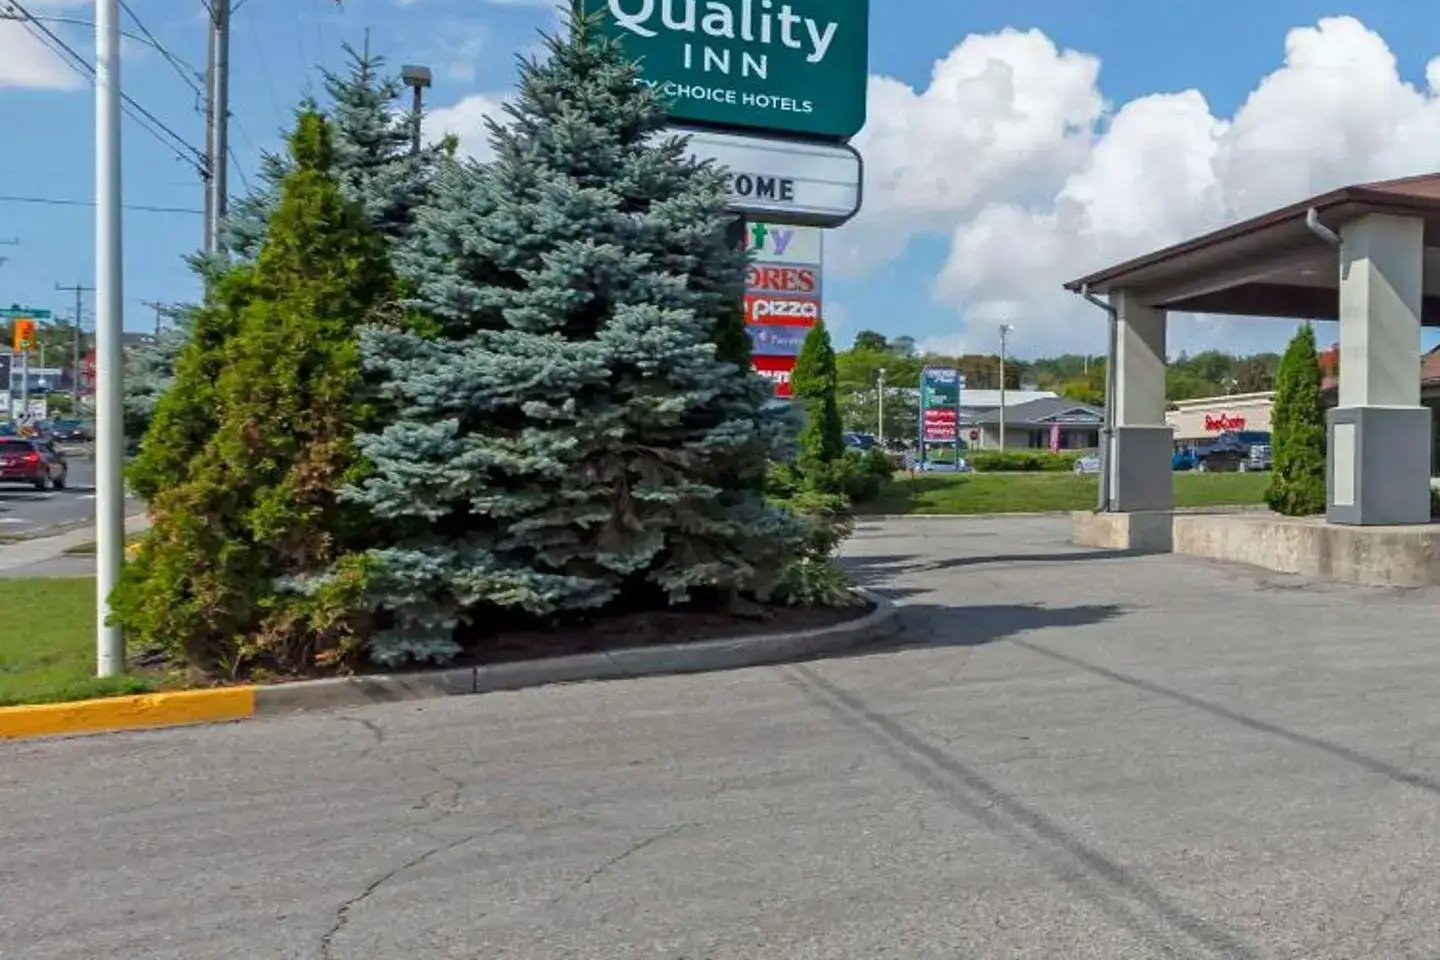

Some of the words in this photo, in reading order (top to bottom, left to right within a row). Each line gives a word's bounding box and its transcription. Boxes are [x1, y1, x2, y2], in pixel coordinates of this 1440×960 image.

[684, 43, 768, 80] INN
[664, 82, 736, 105] CHOICE
[742, 91, 813, 113] HOTELS
[752, 299, 818, 321] pizza
